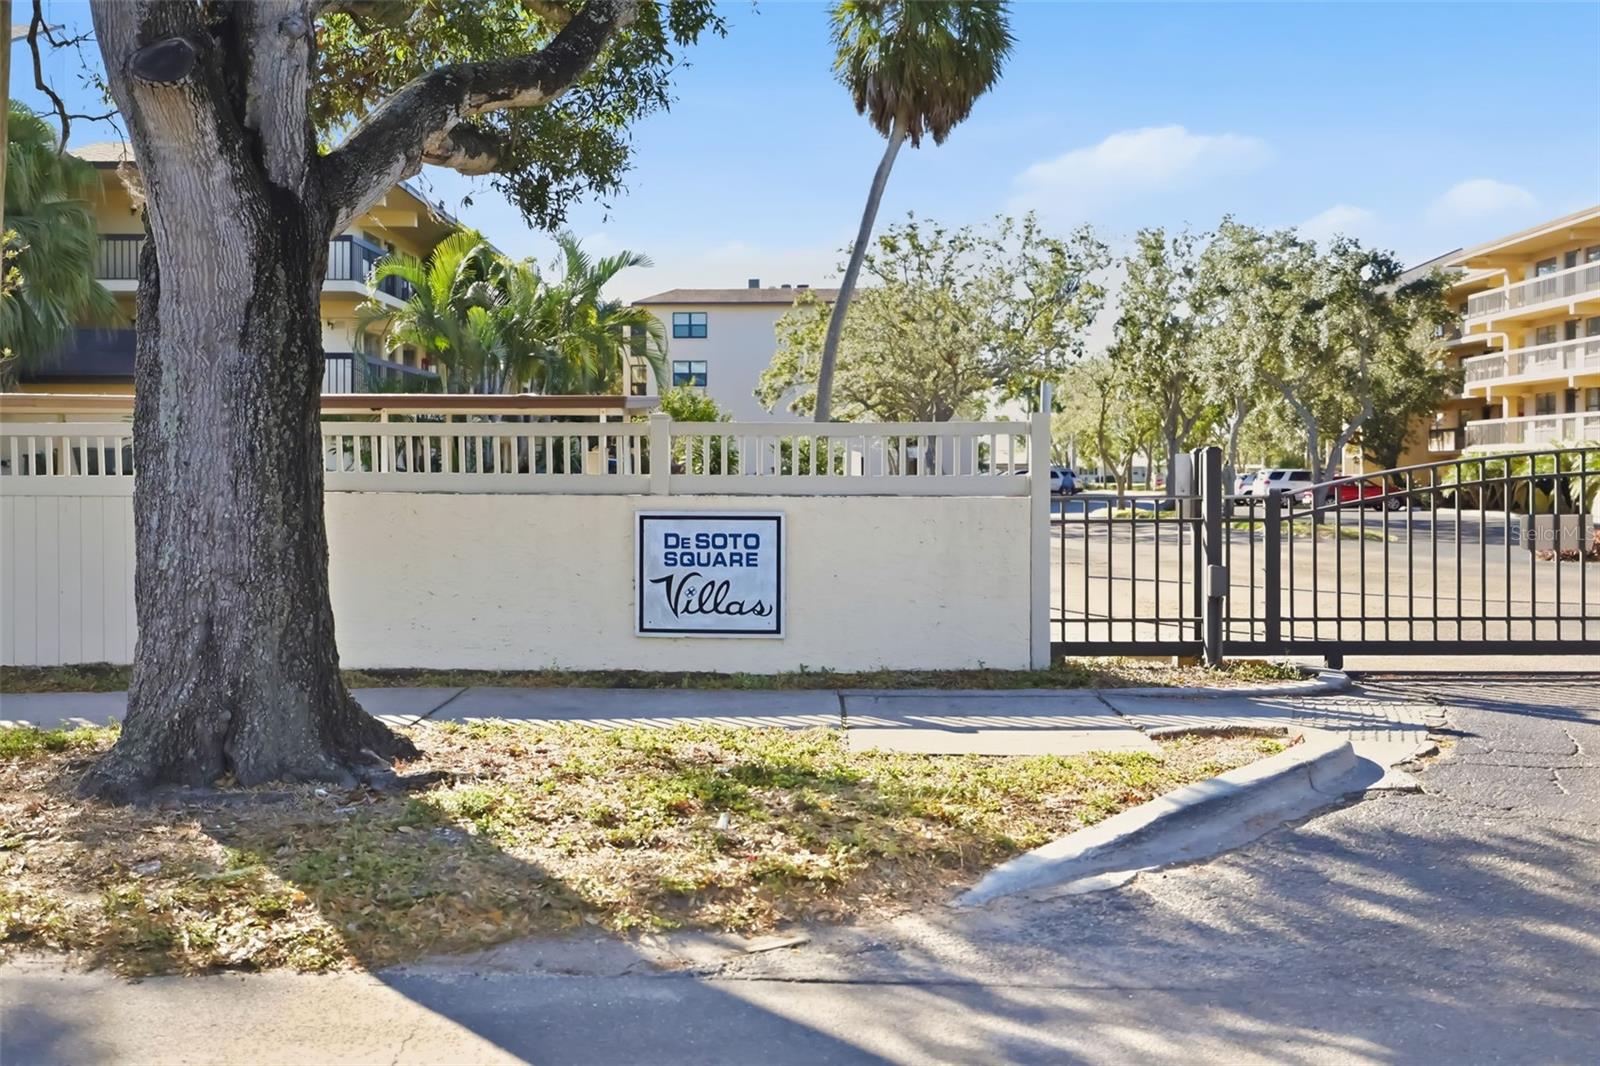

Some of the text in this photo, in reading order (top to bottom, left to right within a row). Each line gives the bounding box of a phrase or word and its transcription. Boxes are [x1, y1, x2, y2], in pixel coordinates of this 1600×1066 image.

[695, 533, 760, 550] SOTO
[664, 551, 759, 567] SQUARE
[649, 572, 773, 619] Villas
